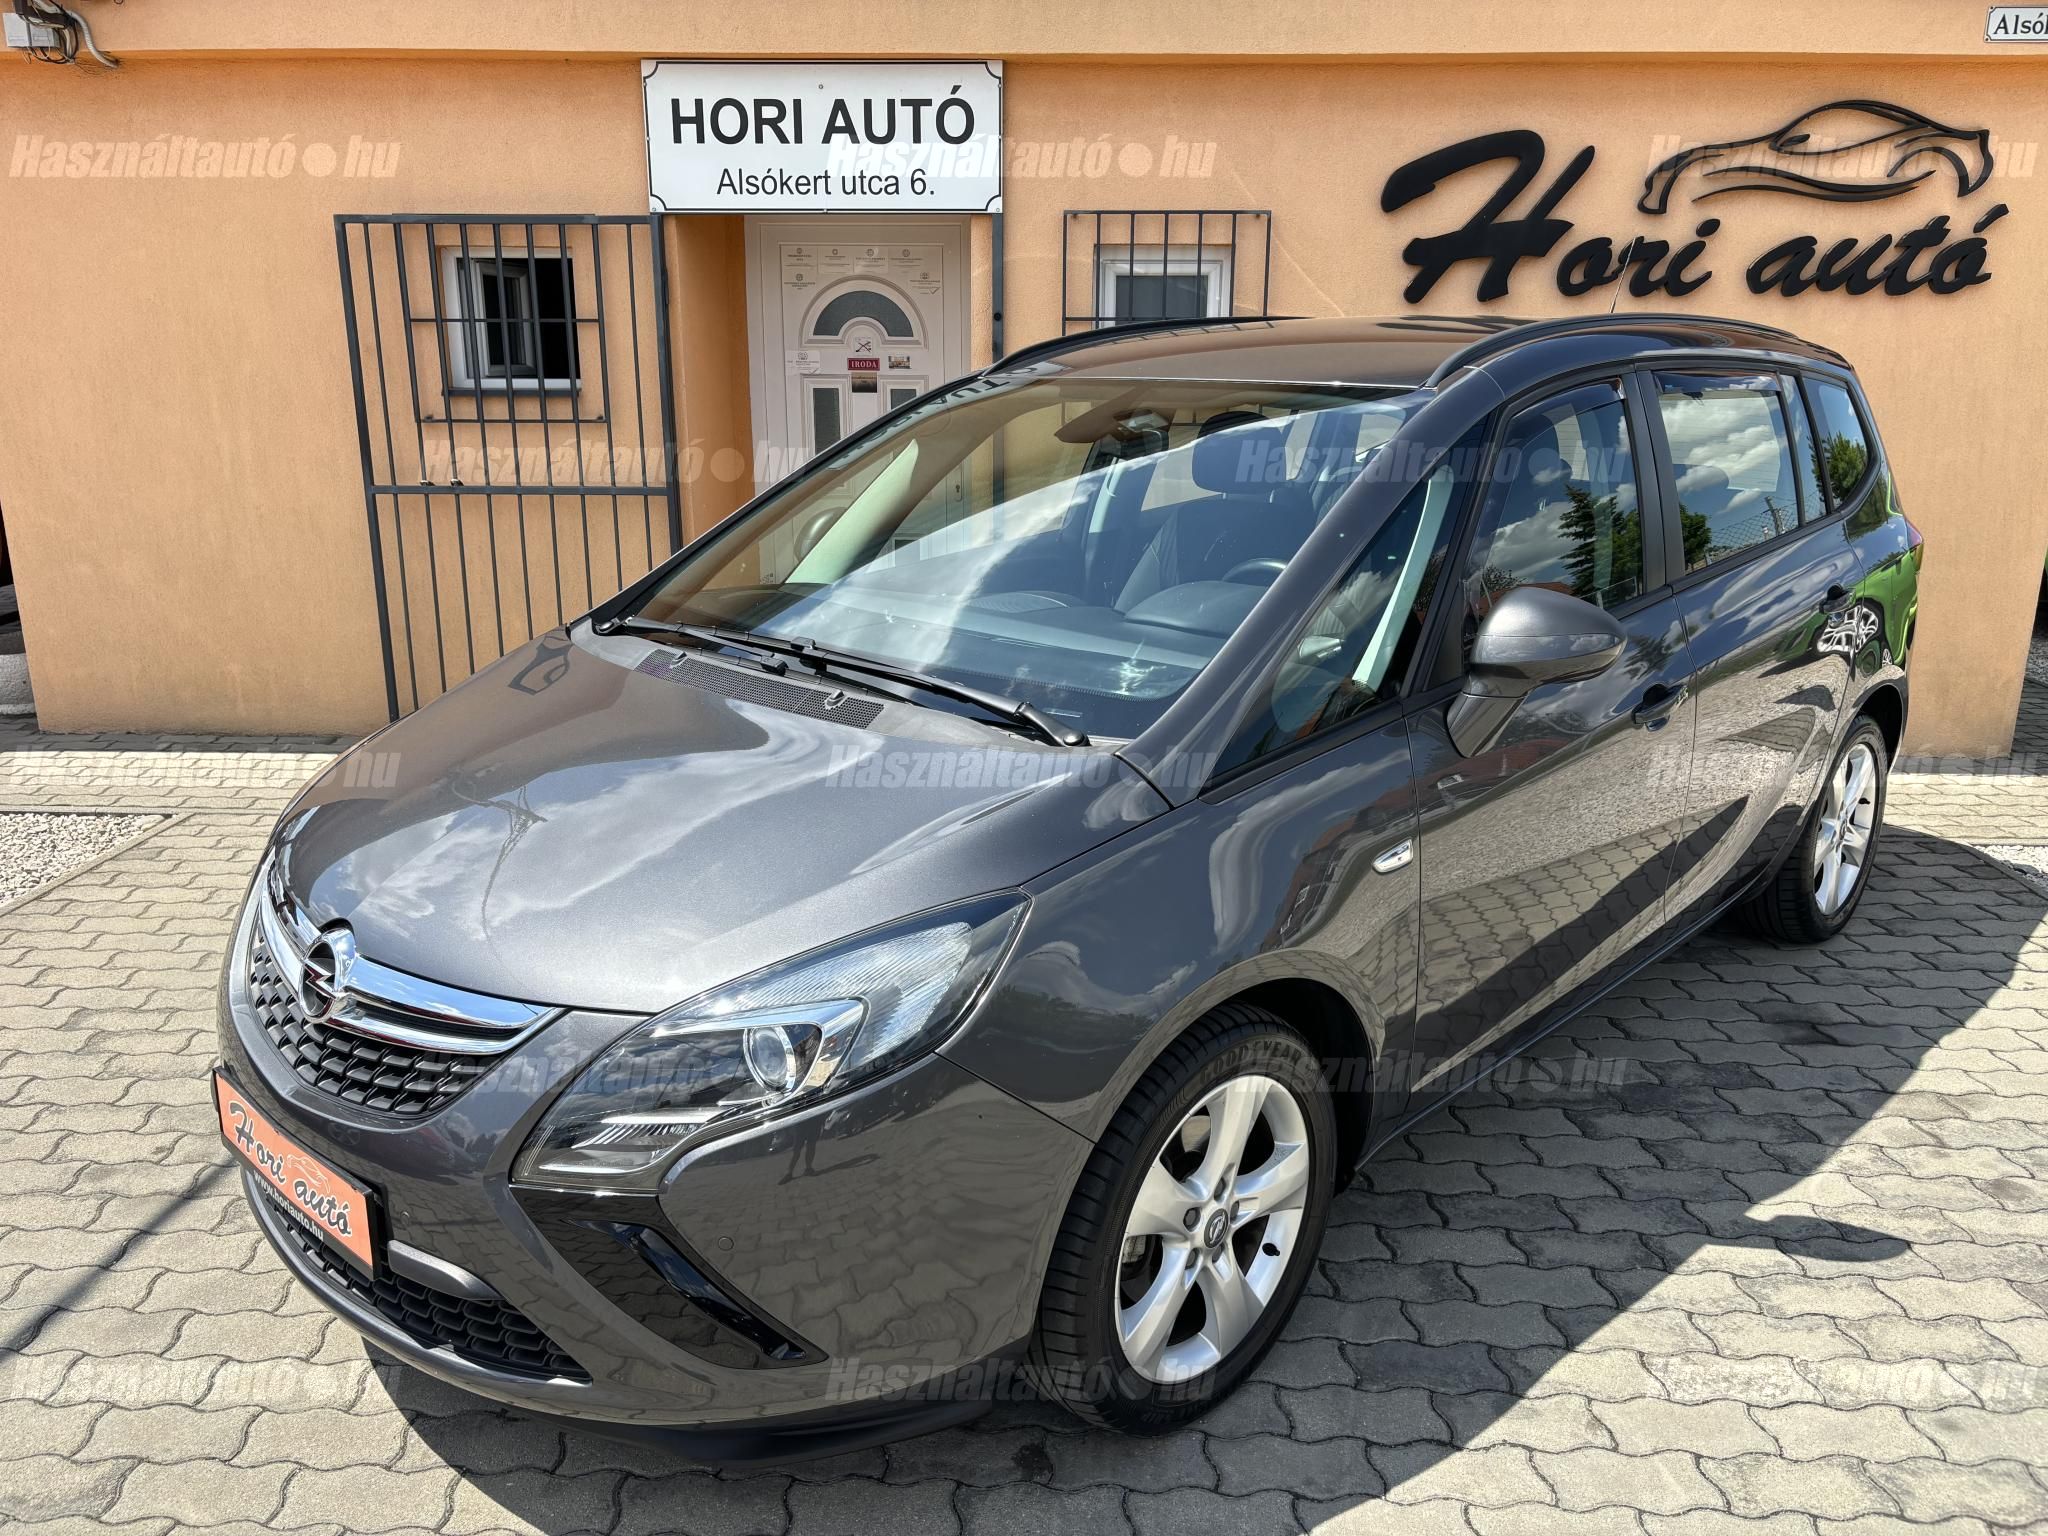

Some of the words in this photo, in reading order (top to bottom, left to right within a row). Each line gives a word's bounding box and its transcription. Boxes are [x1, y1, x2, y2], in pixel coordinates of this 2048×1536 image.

[1992, 12, 2048, 35] Alsó
[671, 97, 803, 145] HORI
[821, 85, 976, 145] AUTÓ
[716, 168, 832, 196] Alsókert
[841, 172, 900, 196] utca
[909, 169, 936, 196] 6.
[1380, 129, 1721, 304] Hori
[1745, 203, 2010, 298] autó
[851, 360, 877, 369] IRODA
[229, 1100, 286, 1184] Hori
[294, 1178, 352, 1237] autó
[253, 1169, 325, 1241] www.horiauto.hu
